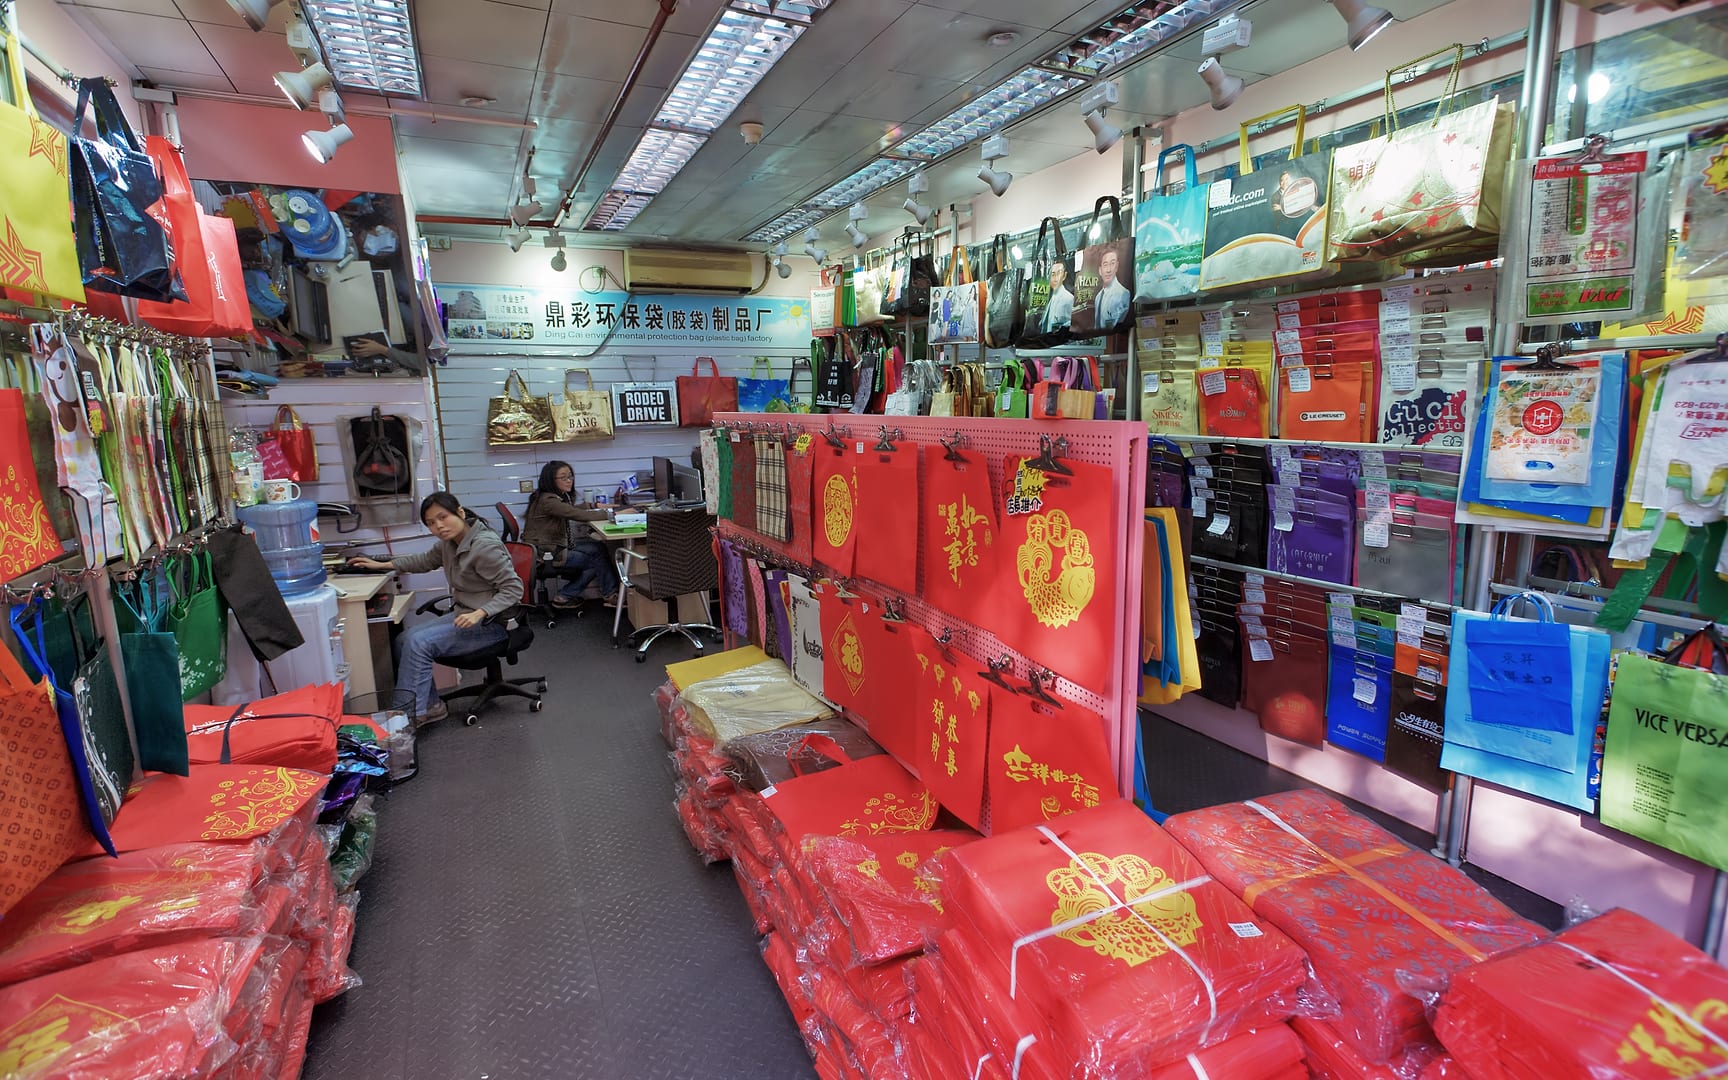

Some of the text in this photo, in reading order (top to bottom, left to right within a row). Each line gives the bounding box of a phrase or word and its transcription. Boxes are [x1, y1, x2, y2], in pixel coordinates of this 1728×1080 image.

[545, 301, 772, 332] 鼎彩环保袋(胶袋)制品厂
[544, 330, 566, 339] Ding
[572, 330, 584, 339] Cai
[647, 332, 688, 341] protection
[689, 333, 704, 342] bag
[747, 335, 773, 343] factory
[625, 391, 664, 406] RODEO
[568, 417, 598, 429] BANG
[627, 407, 666, 421] DRIVE
[1383, 420, 1466, 441] collectio
[841, 633, 862, 675] 福
[1635, 708, 1669, 734] VICE
